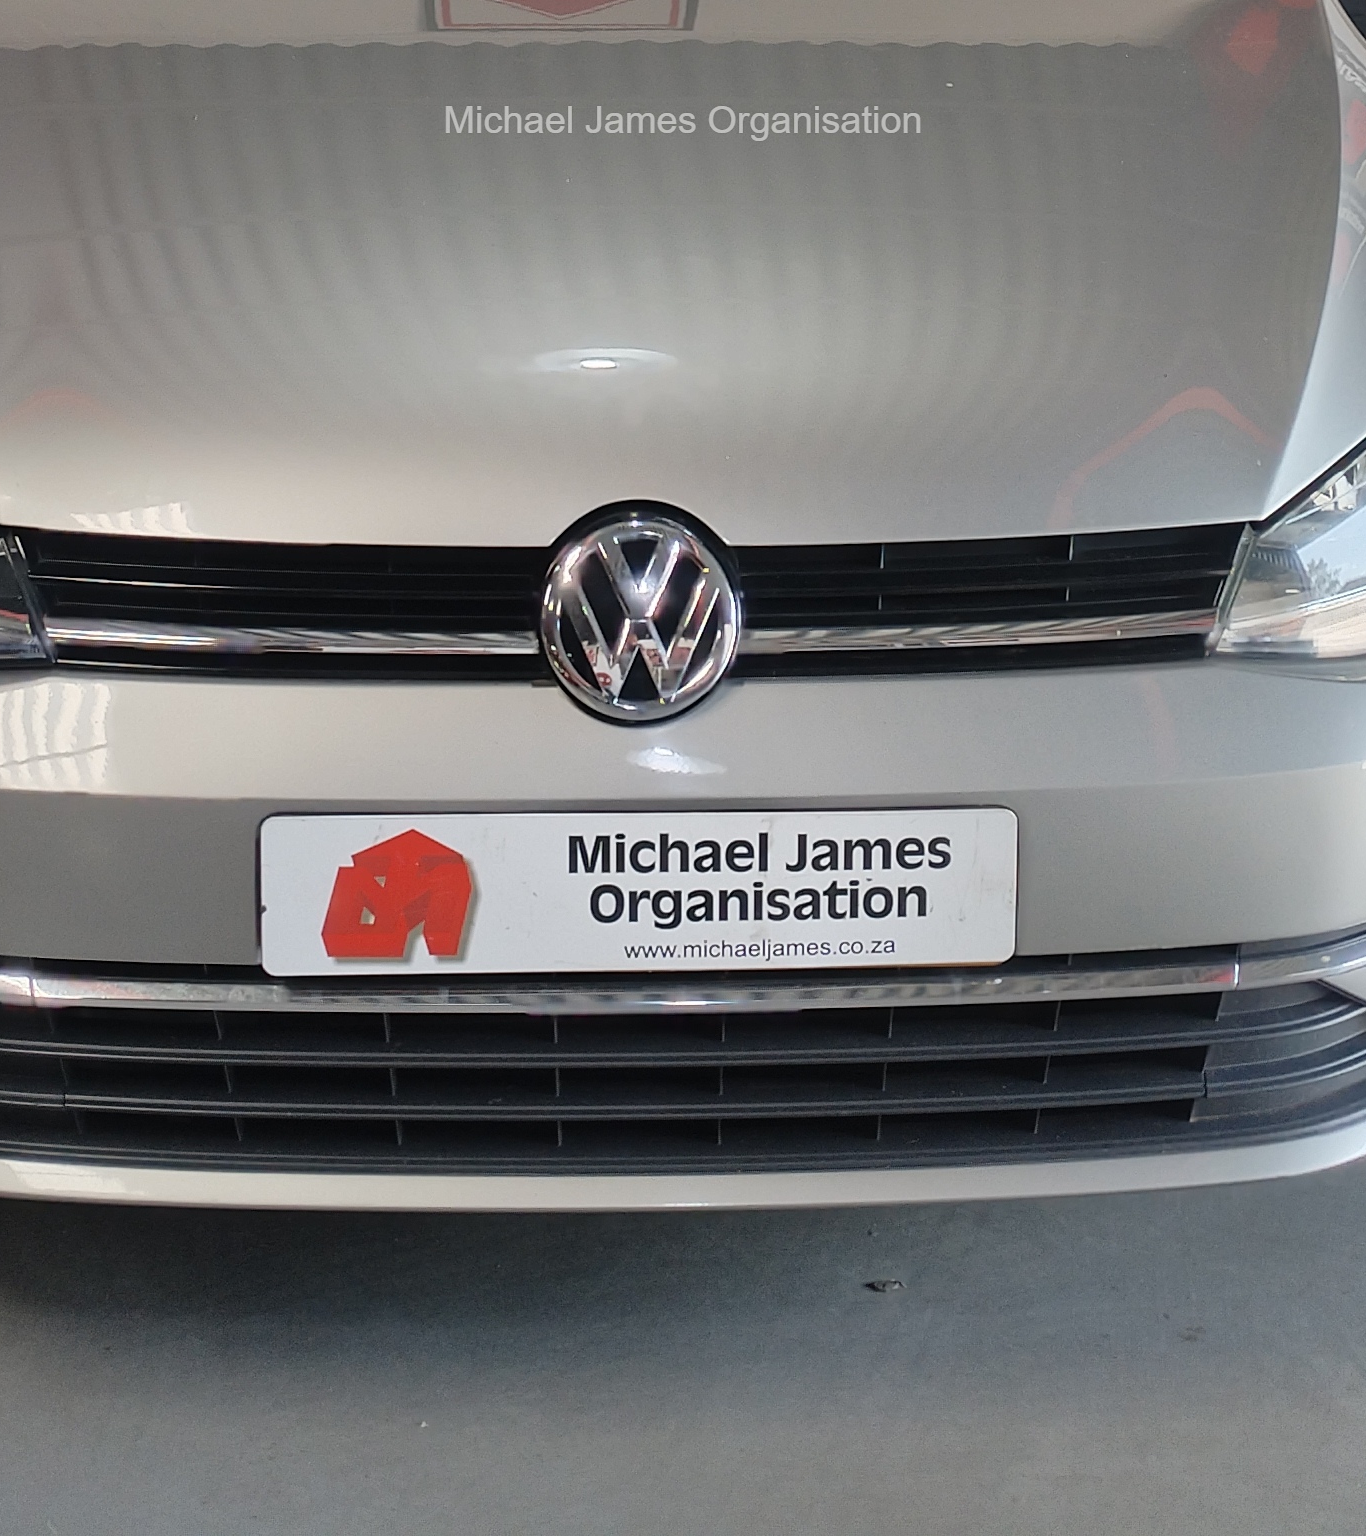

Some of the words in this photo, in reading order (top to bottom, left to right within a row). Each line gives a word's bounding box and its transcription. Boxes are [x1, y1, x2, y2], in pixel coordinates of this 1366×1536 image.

[569, 833, 768, 873] Michael
[786, 834, 951, 872] James
[590, 879, 926, 929] Organisation
[624, 939, 895, 961] www.michaeljames.co.za
